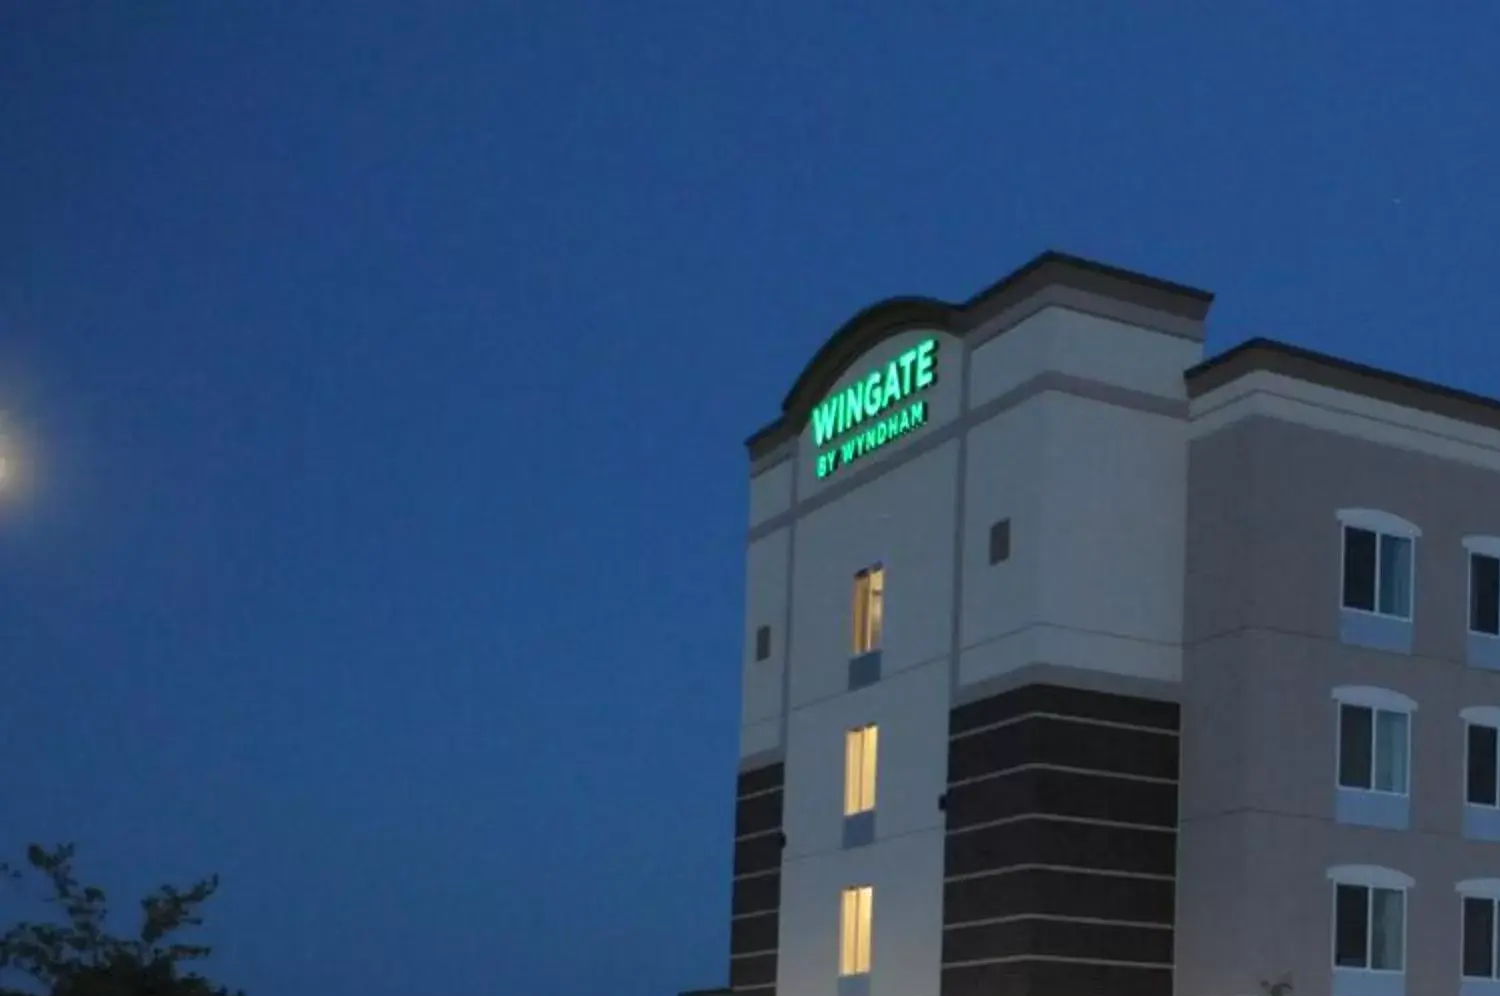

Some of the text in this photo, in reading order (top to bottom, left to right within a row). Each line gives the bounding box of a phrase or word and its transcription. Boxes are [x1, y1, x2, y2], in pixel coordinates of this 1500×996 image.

[811, 338, 936, 447] WINGATE
[816, 401, 924, 478] BY WYNDHAM
